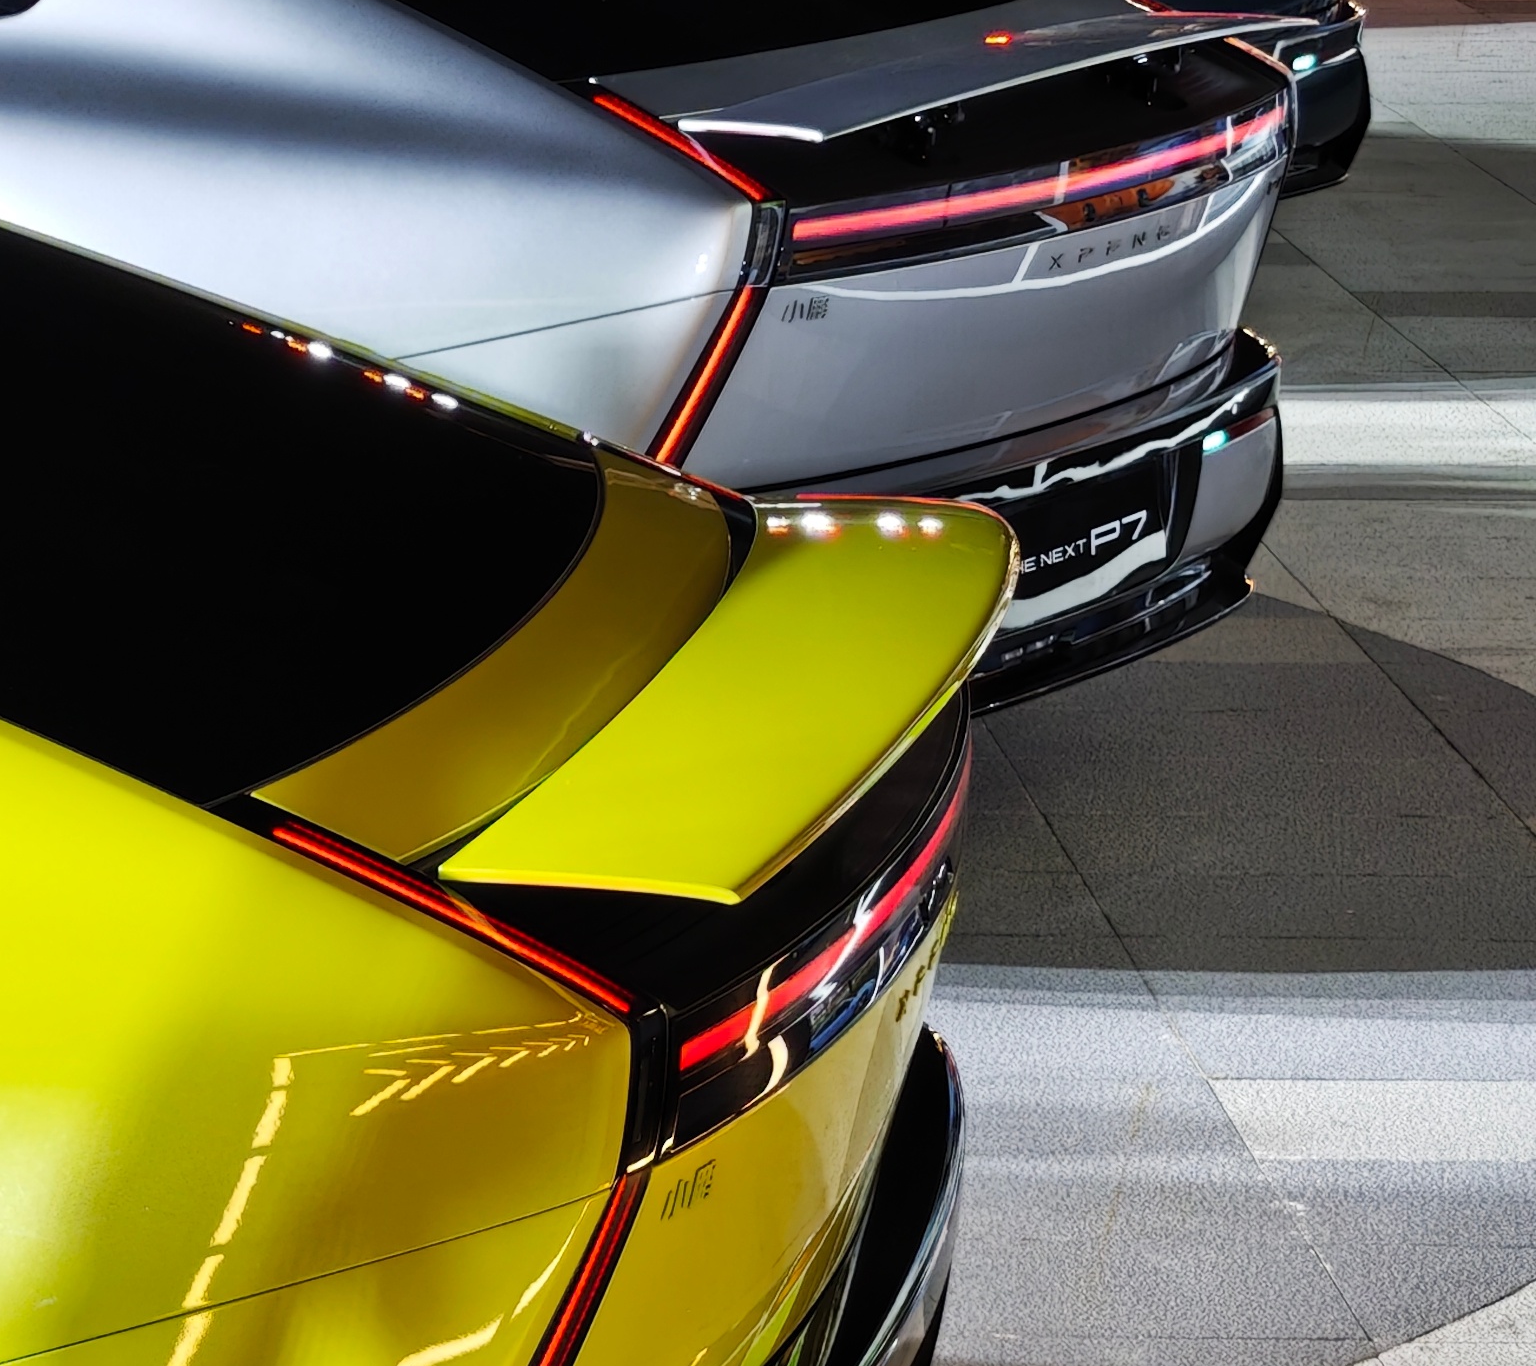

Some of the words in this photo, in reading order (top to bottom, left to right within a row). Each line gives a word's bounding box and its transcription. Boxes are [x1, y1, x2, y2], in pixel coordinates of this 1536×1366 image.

[1019, 556, 1037, 574] HE
[1039, 538, 1087, 567] NEXT
[1090, 509, 1148, 556] P7
